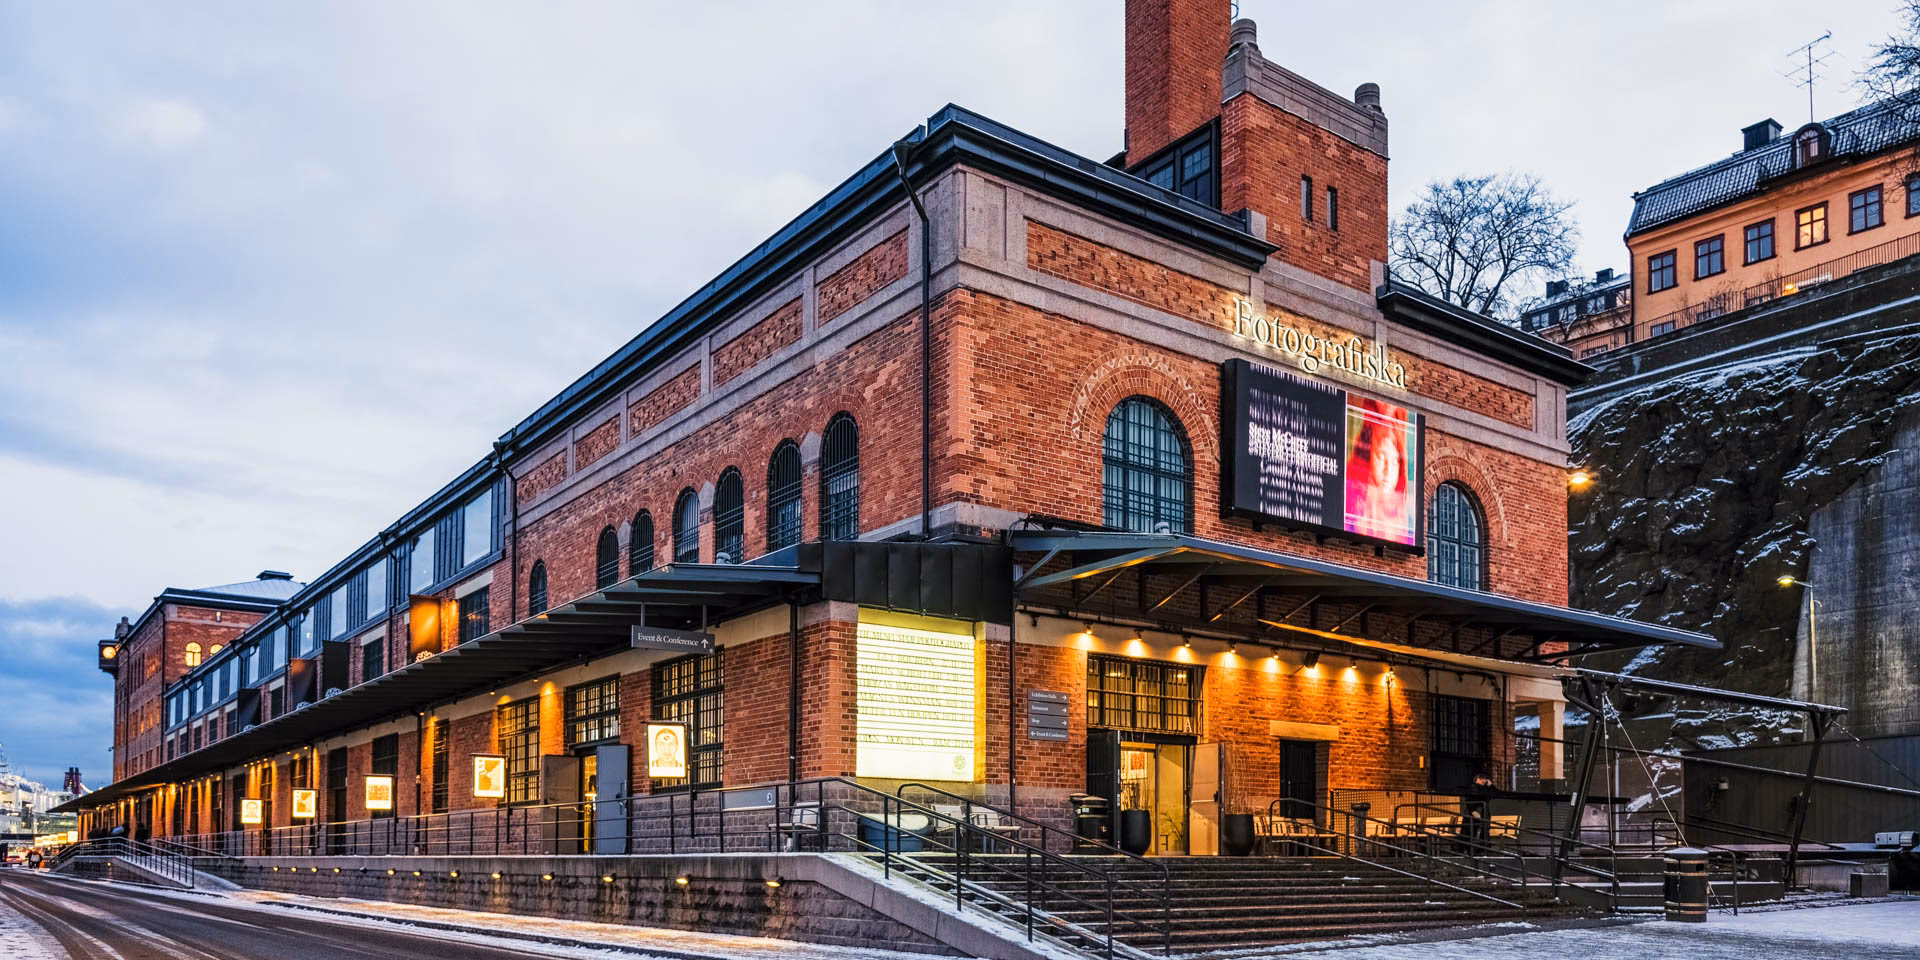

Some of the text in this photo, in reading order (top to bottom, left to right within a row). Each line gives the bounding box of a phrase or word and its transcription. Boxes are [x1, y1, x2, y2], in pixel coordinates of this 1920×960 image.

[1233, 297, 1407, 389] Fotografiska
[637, 632, 699, 646] Event & Conference
